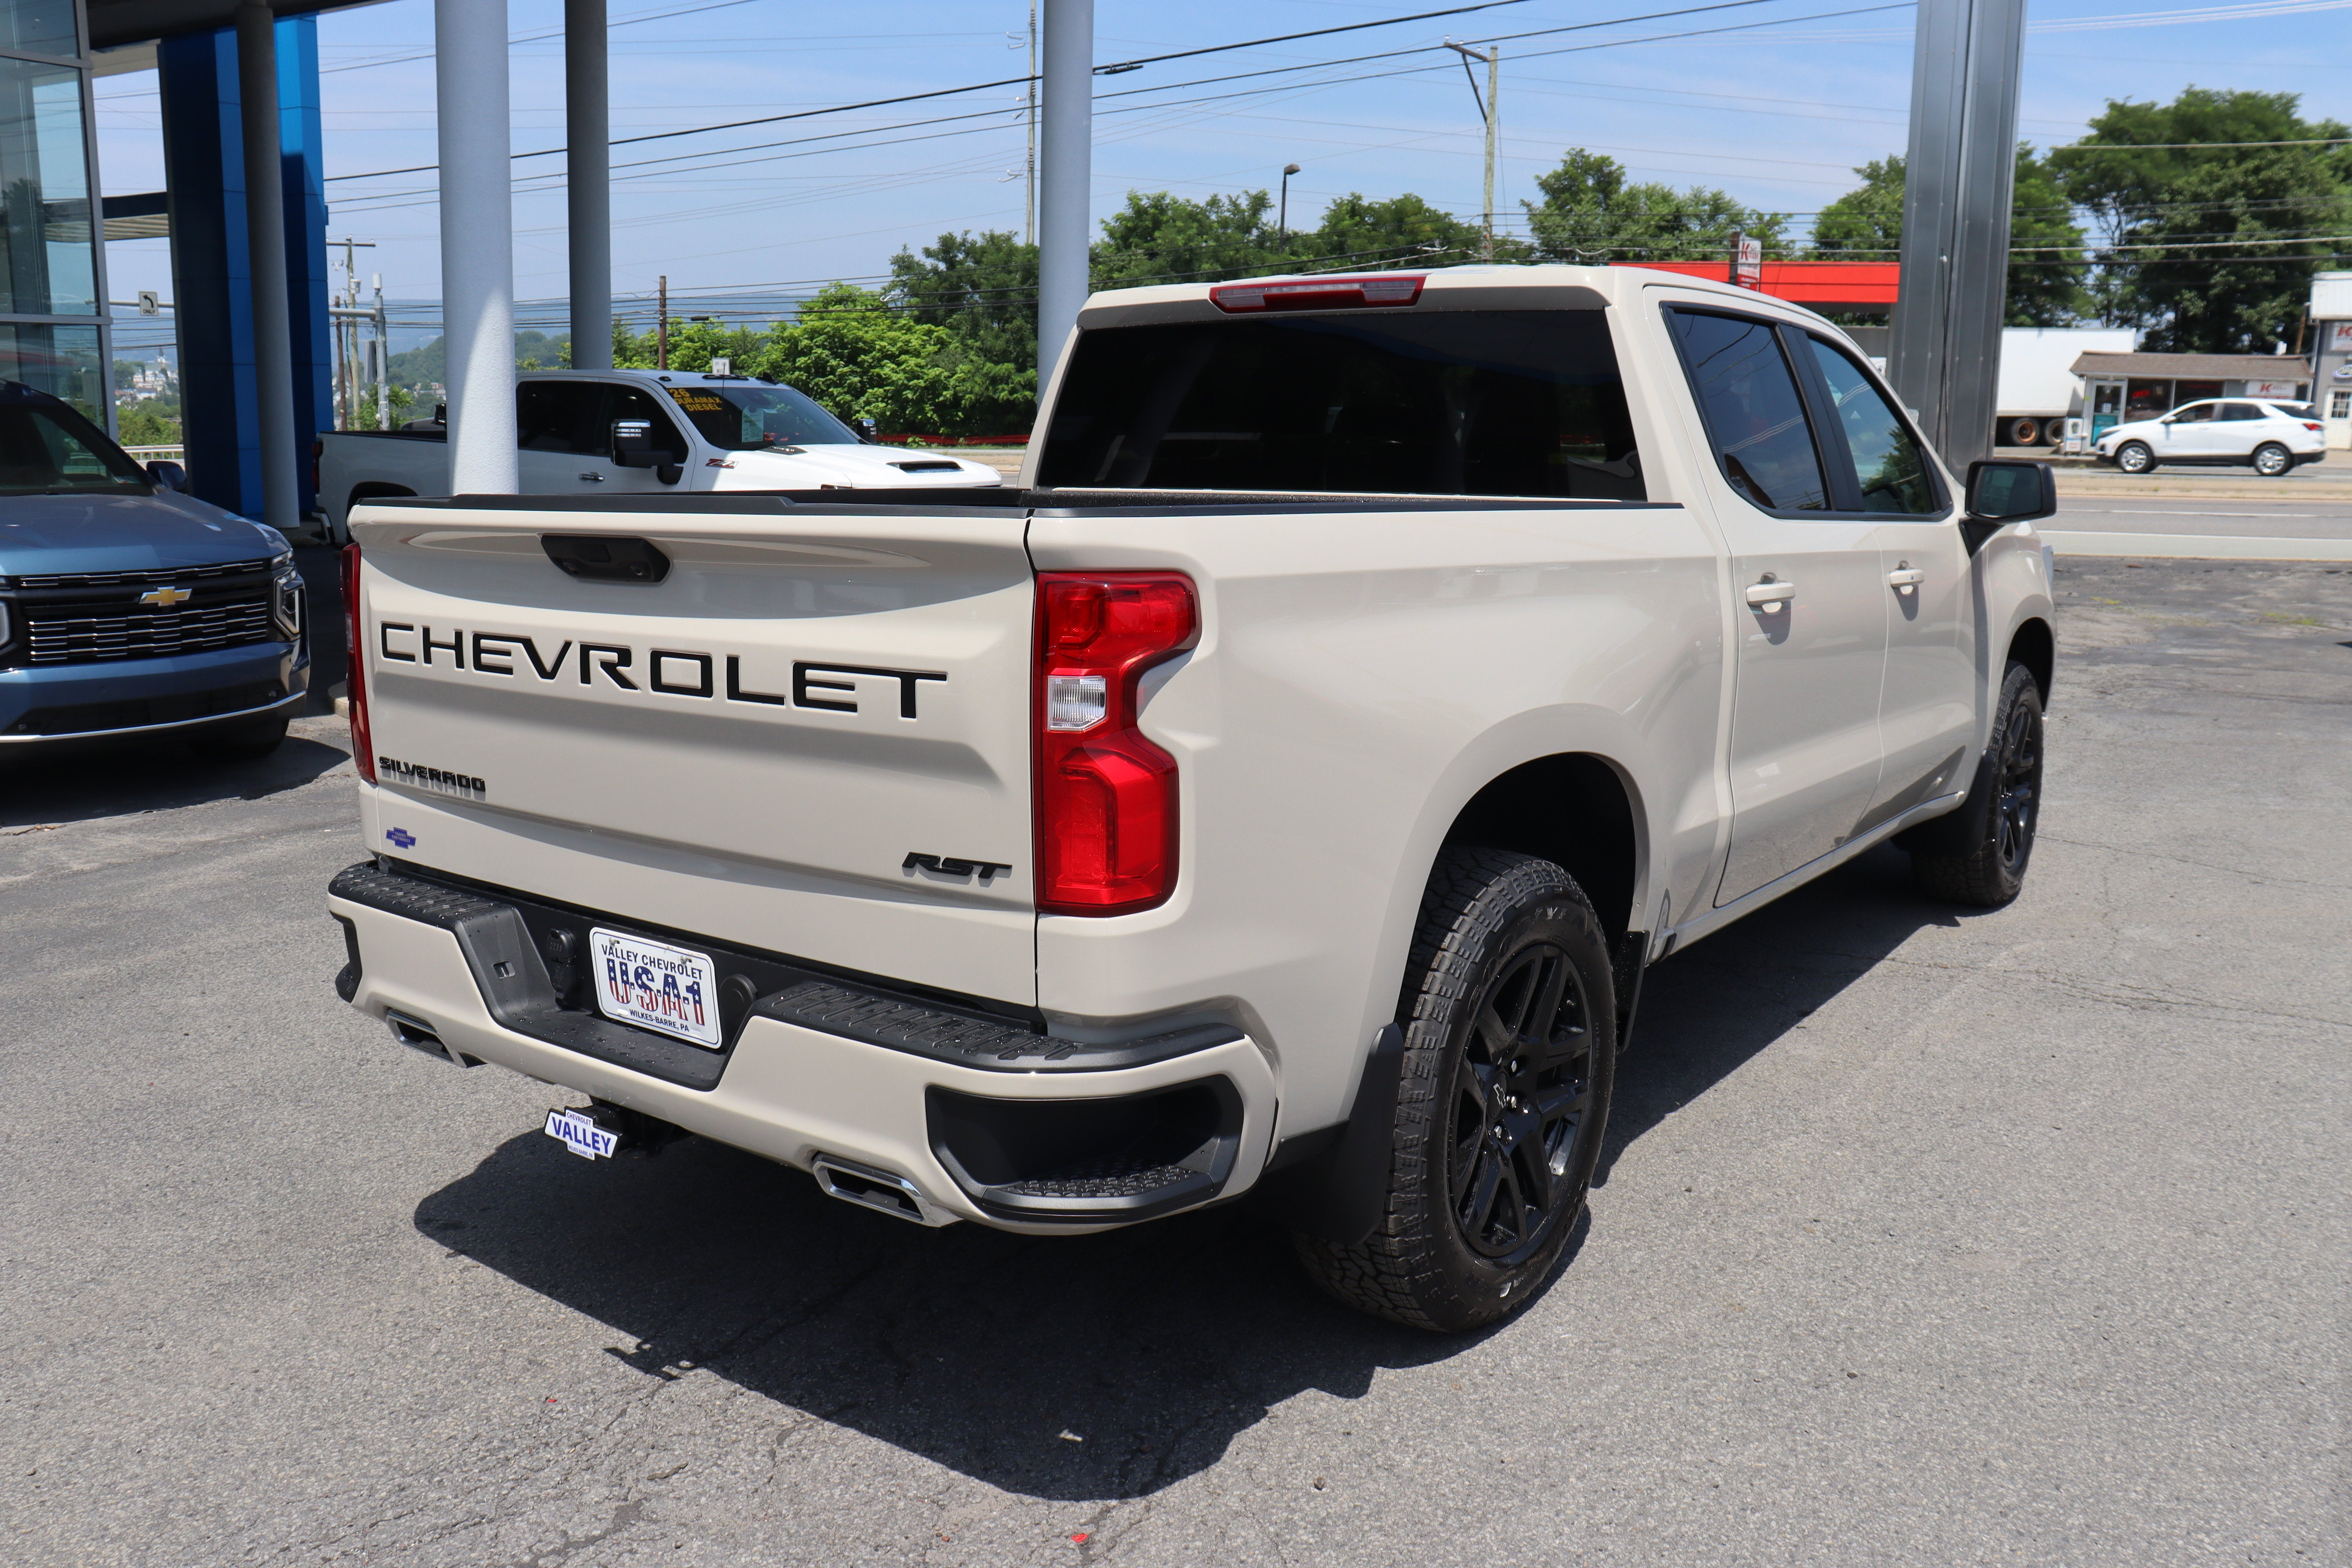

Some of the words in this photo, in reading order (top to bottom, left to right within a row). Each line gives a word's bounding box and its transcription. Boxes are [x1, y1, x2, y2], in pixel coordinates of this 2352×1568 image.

[705, 458, 738, 469] Z71
[381, 622, 948, 719] CHEVROLET
[379, 756, 486, 792] SILVERADO
[902, 851, 1013, 879] RST
[601, 944, 638, 963] VALLEY
[641, 954, 703, 980] CHEVROLET
[629, 1009, 679, 1031] WILKES-BARRE,
[680, 1023, 690, 1032] PA
[566, 1111, 592, 1126] CHEVROLET
[552, 1116, 611, 1155] VALLEY
